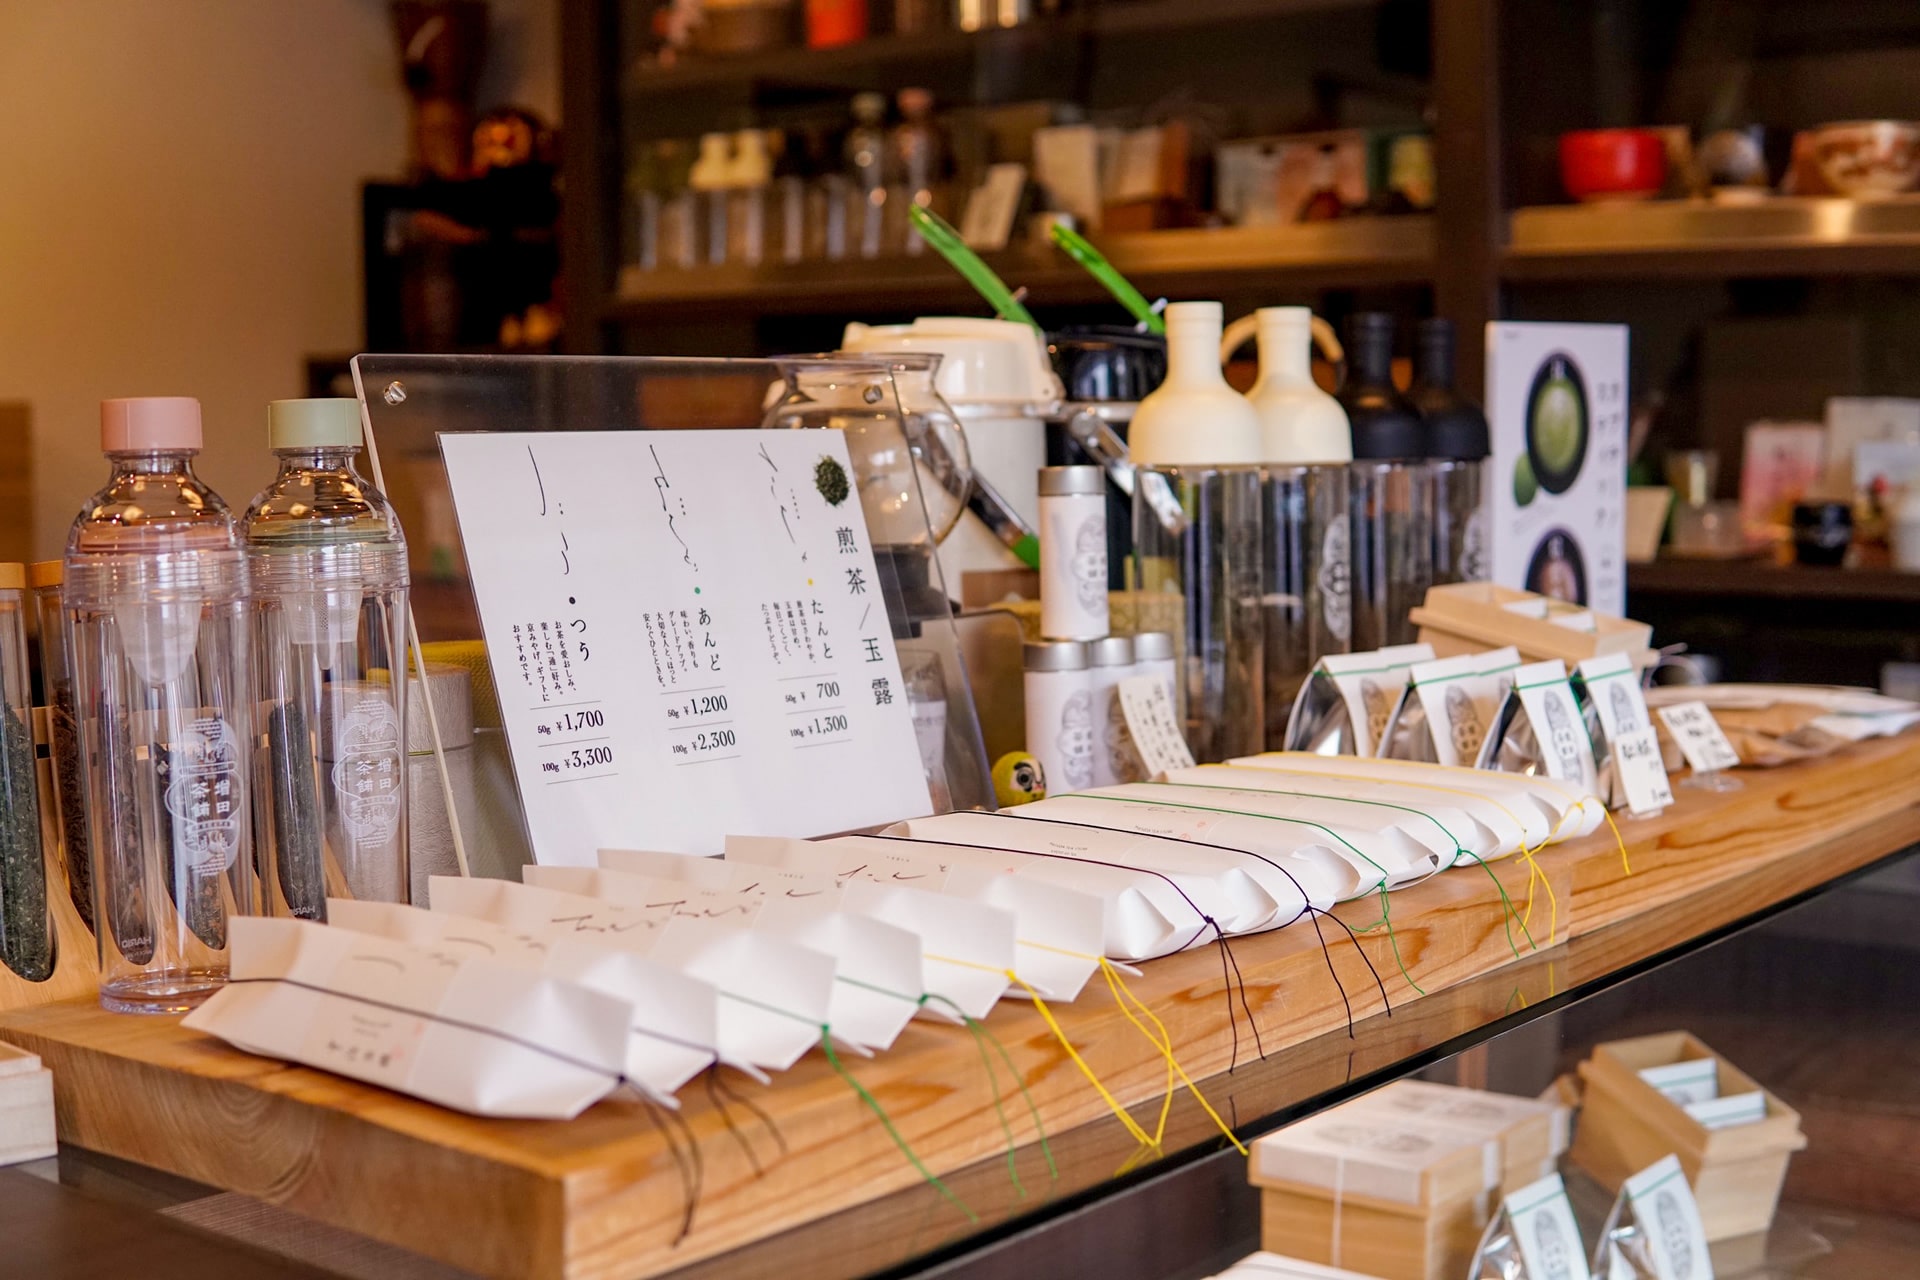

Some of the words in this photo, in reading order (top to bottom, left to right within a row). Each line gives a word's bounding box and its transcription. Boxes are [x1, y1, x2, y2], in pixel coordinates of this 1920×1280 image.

[570, 619, 590, 662] つう
[698, 607, 721, 671] あんど
[811, 599, 833, 659] たんと
[513, 624, 533, 686] おすすめです。
[526, 622, 550, 702] 京みやげ、ギフトに
[555, 620, 577, 691] お茶を愛おしみ、
[785, 694, 797, 704] 50g
[667, 708, 680, 719] 50g
[537, 724, 552, 735] 50g
[790, 728, 805, 738] 100g
[672, 744, 688, 754] 100g
[542, 762, 560, 773] 100g
